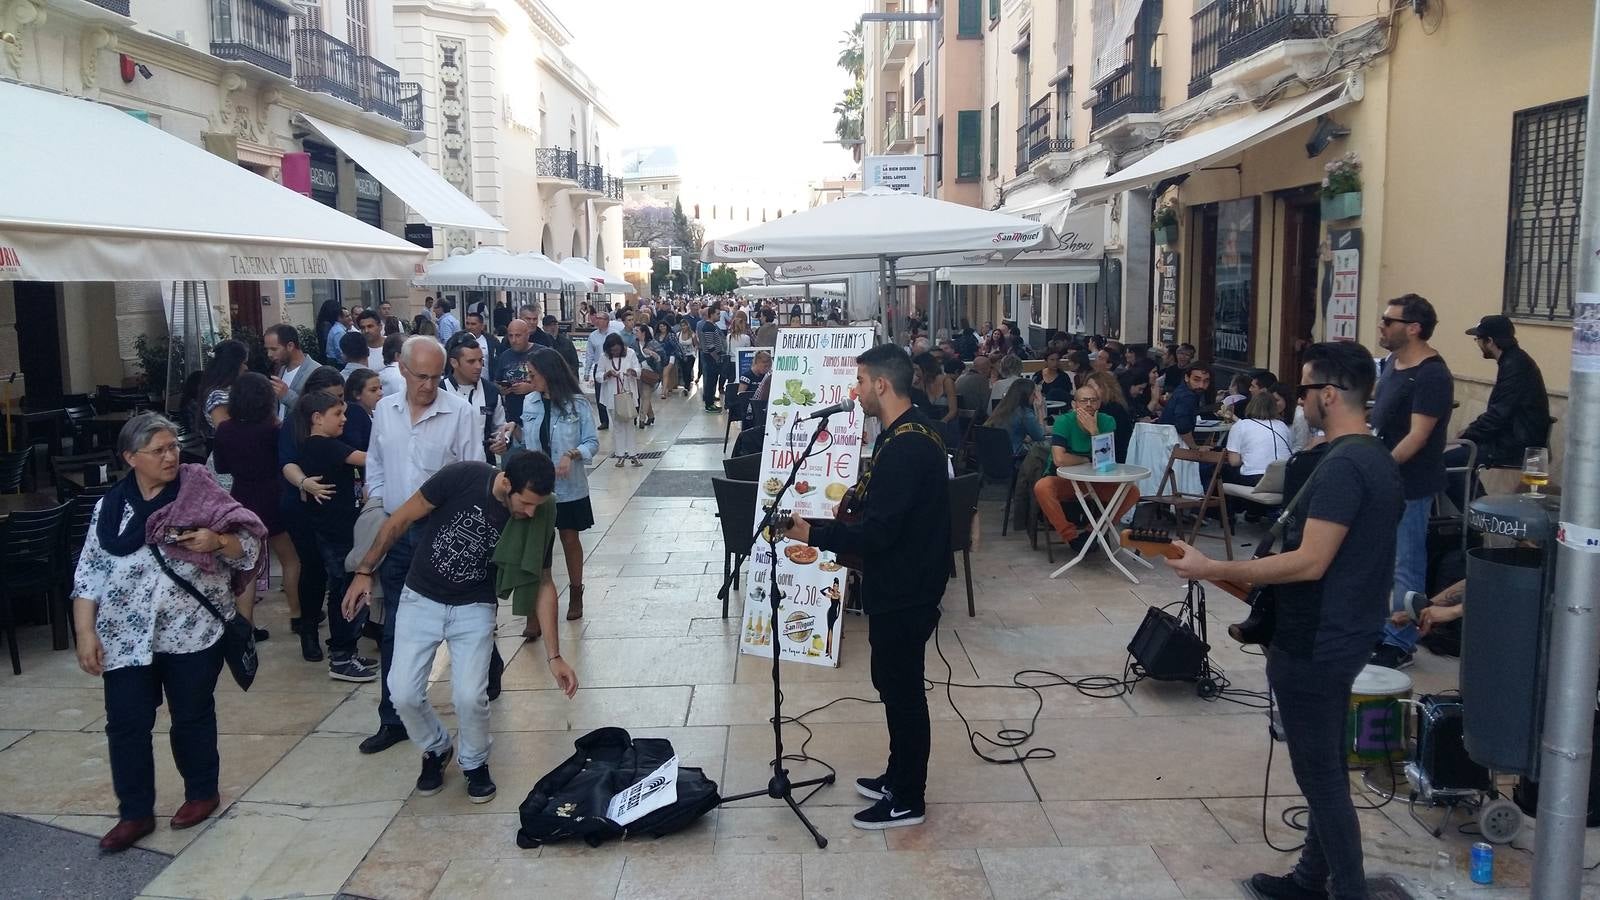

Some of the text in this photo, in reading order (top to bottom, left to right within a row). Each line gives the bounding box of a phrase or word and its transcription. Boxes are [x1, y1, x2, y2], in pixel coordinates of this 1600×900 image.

[279, 257, 299, 275] DEL
[300, 257, 328, 275] TAPEO
[782, 333, 820, 350] BREAKFAST
[775, 355, 800, 371] MOJITOS
